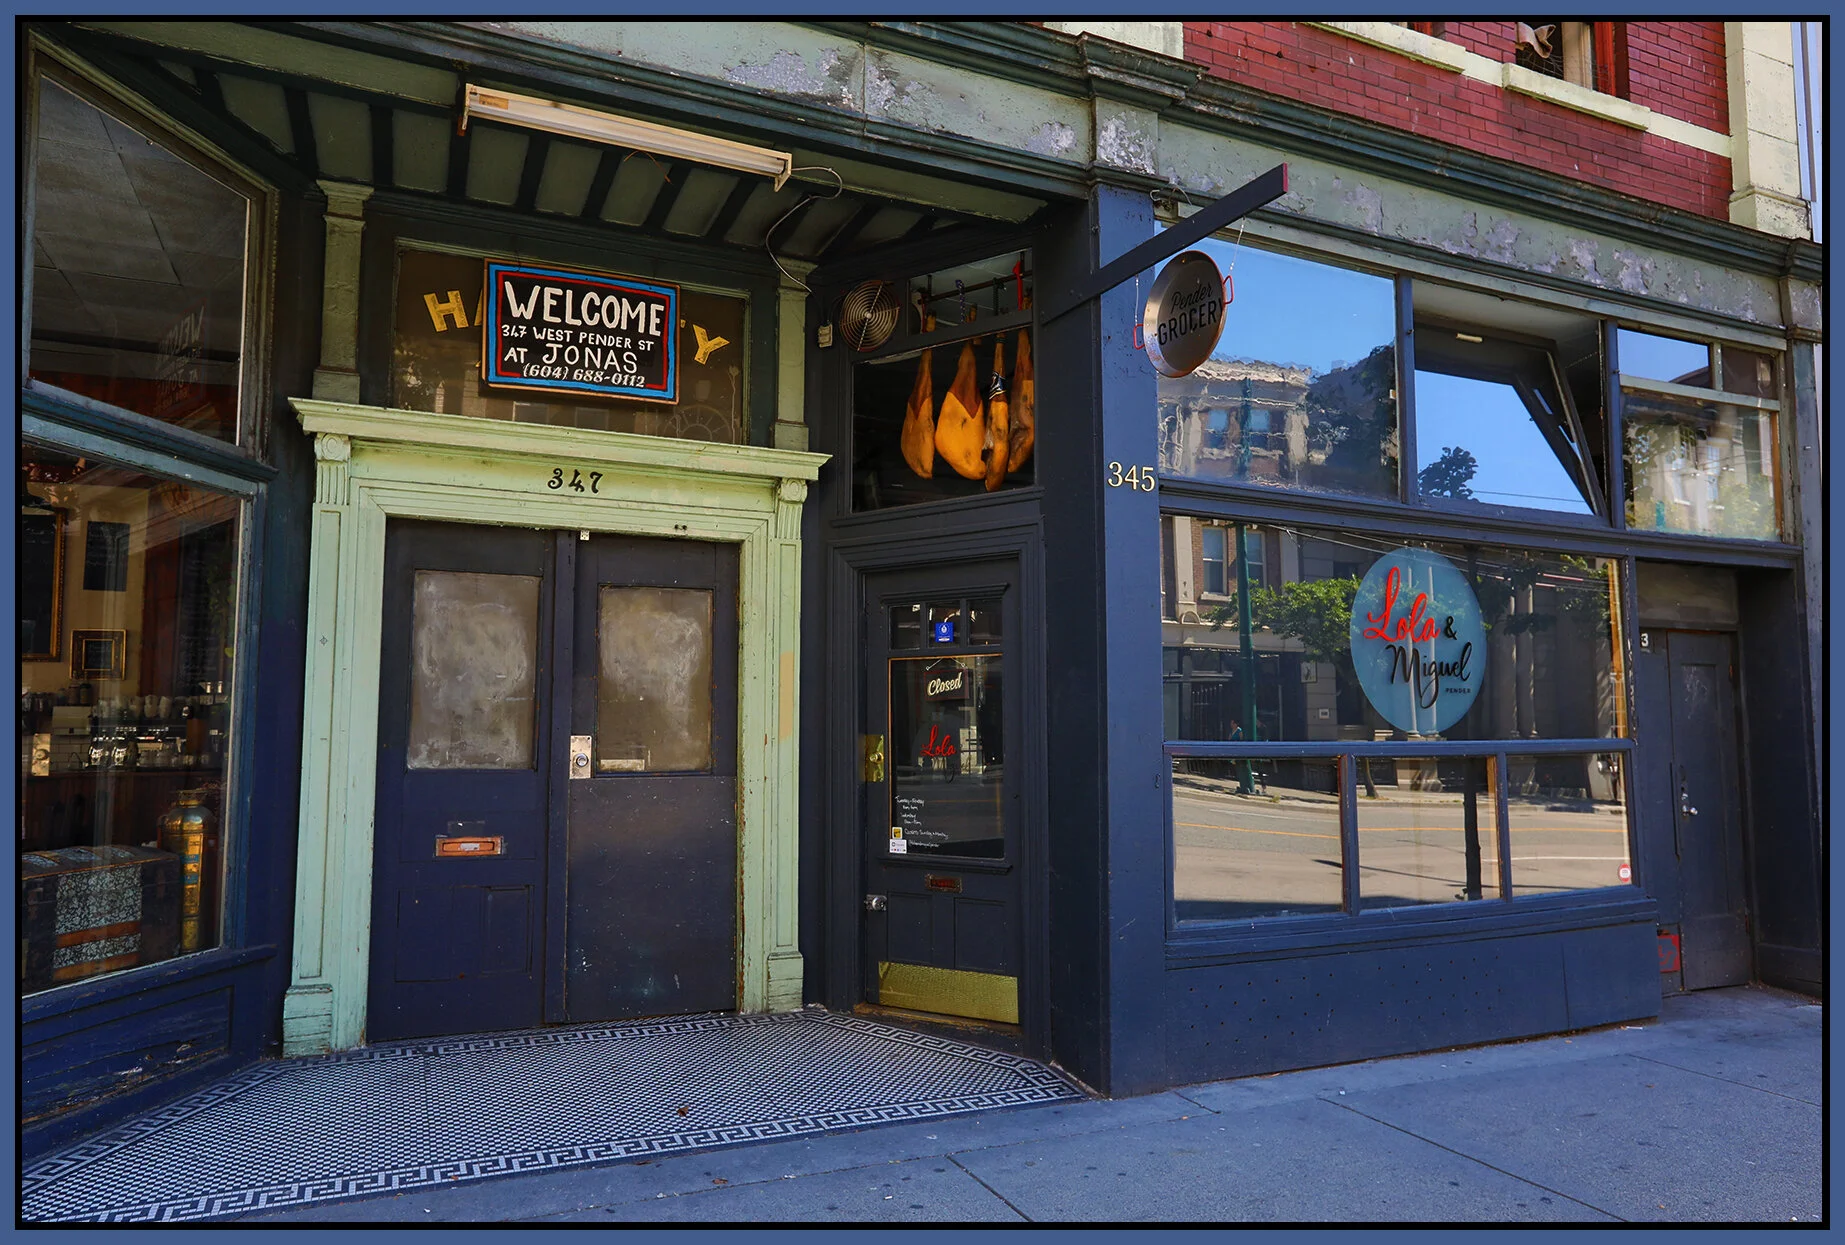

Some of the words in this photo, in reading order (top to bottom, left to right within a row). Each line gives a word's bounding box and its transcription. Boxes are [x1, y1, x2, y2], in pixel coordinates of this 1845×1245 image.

[504, 281, 665, 337] WELCOME
[1170, 281, 1214, 314] Pender
[501, 324, 527, 339] 347
[533, 327, 573, 343] WEST
[579, 331, 632, 350] PENDER
[638, 339, 655, 352] ST
[504, 347, 528, 364] AT
[542, 343, 638, 374] JONAS
[522, 363, 569, 381] (604)
[572, 369, 646, 388] 688-0112
[547, 467, 603, 494] 347
[1107, 461, 1155, 492] 345
[1363, 566, 1440, 643] Lola
[1443, 615, 1458, 641] &
[927, 671, 963, 697] Closed
[1385, 641, 1473, 709] Miguel
[920, 724, 957, 757] Lola
